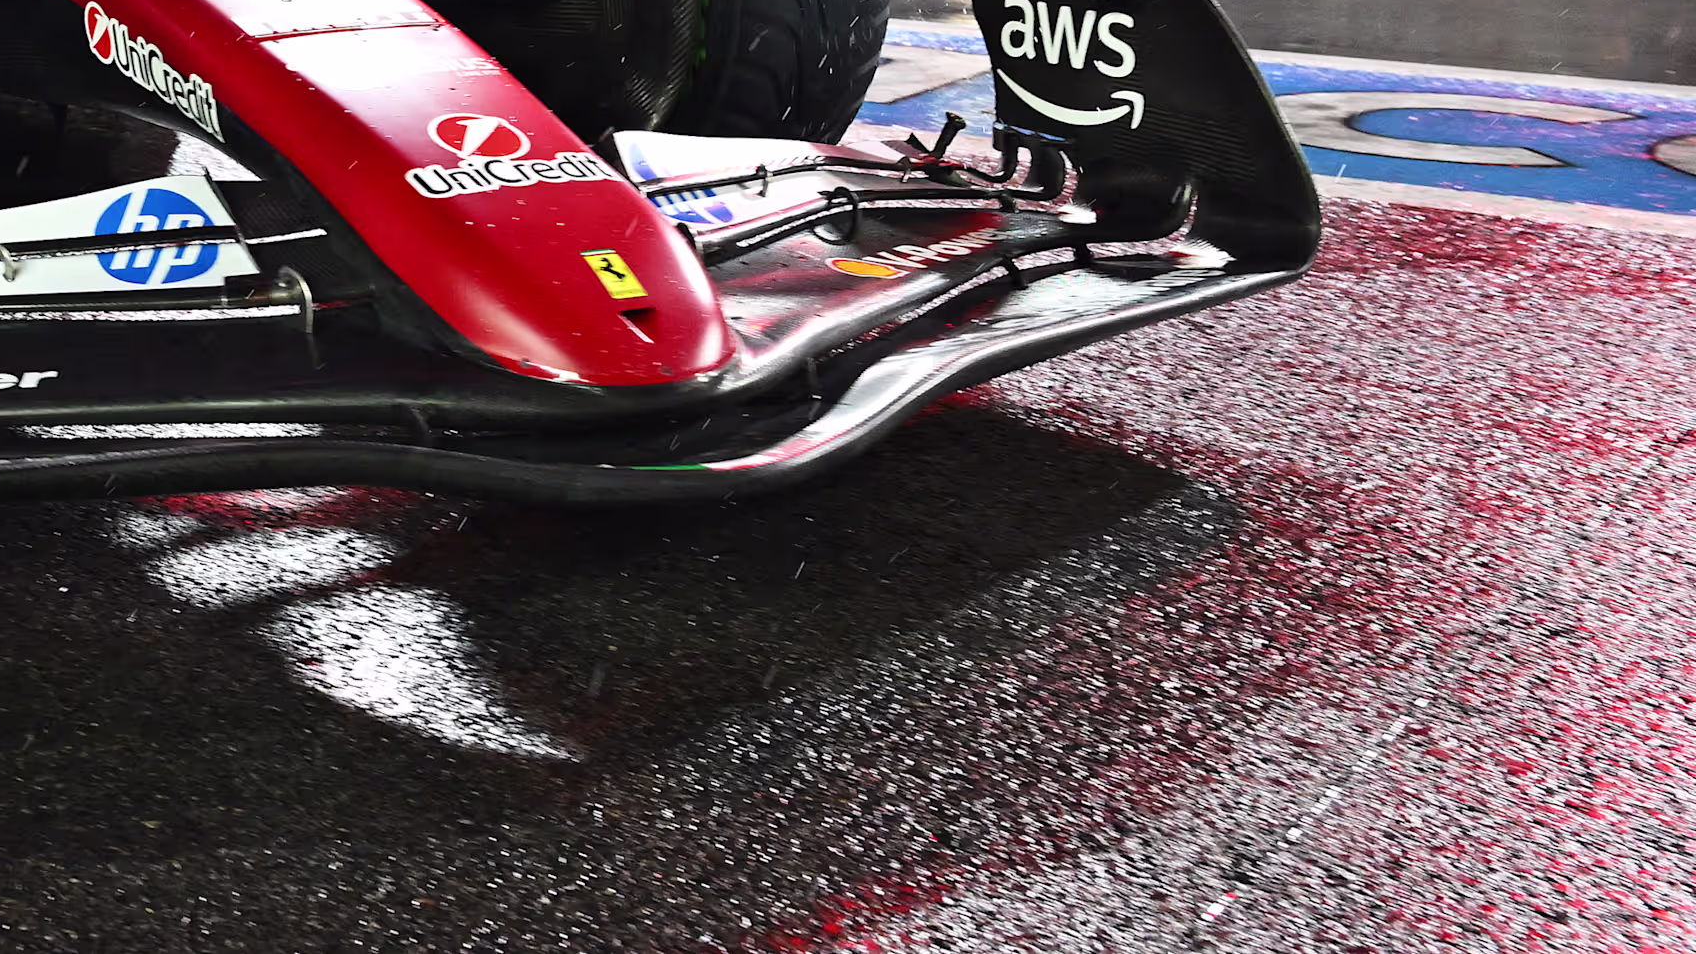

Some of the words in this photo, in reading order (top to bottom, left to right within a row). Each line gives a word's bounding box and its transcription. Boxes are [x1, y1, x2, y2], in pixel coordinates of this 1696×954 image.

[111, 22, 221, 140] UniCredit
[413, 153, 615, 197] UniCredit
[103, 189, 209, 286] hp
